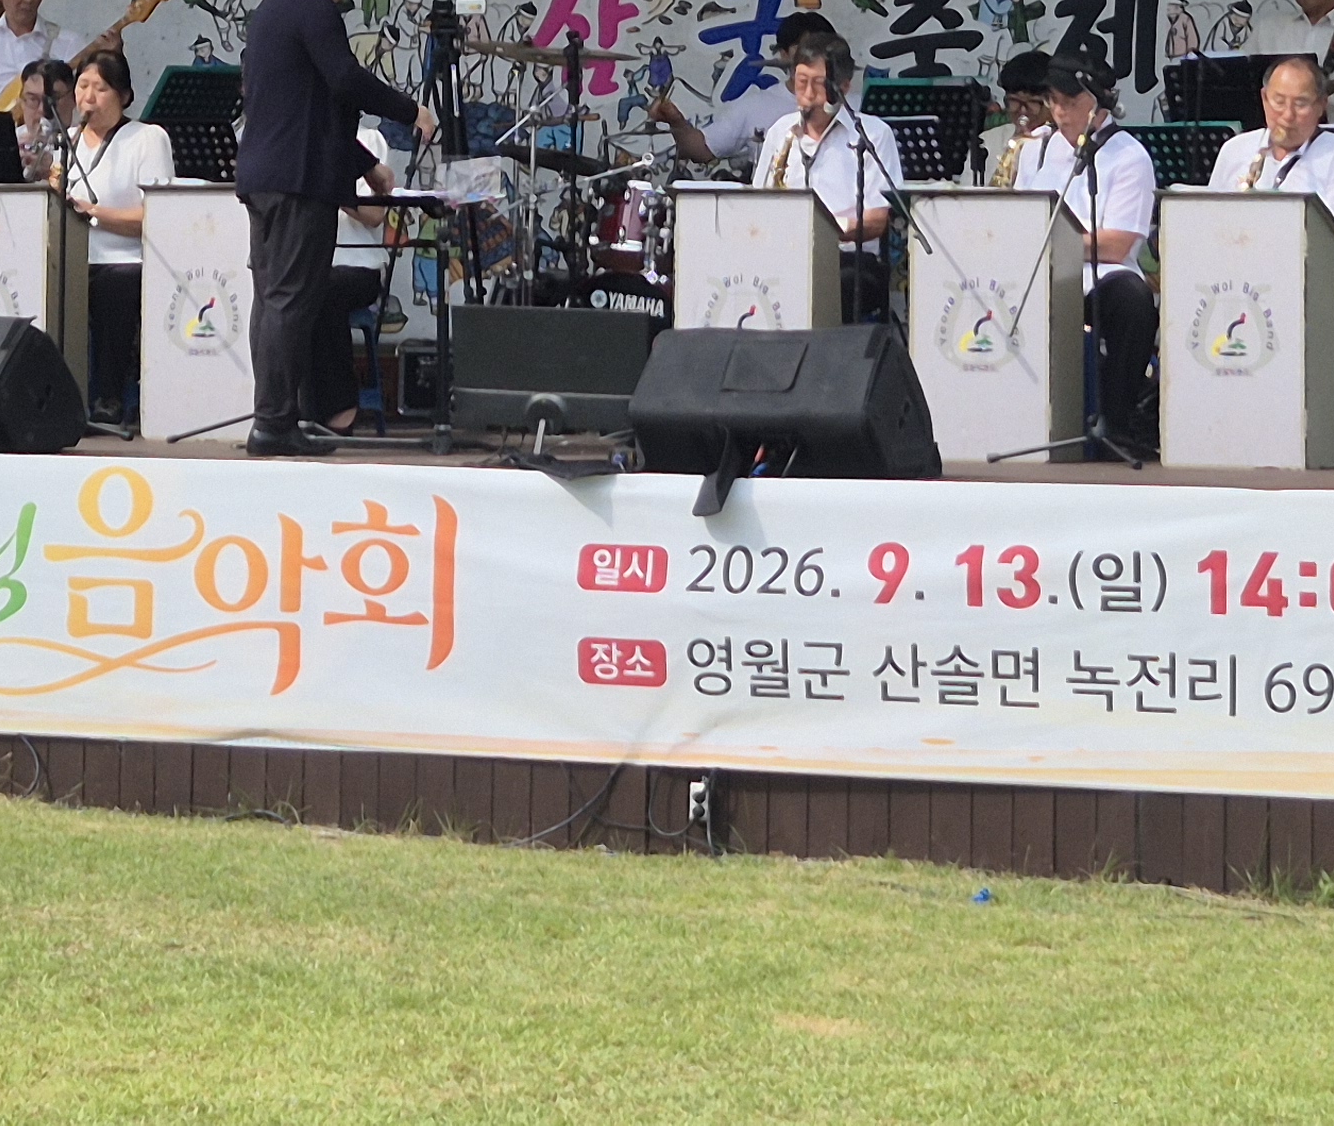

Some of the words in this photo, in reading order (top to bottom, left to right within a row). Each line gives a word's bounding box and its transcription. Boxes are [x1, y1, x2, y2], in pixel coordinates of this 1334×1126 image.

[608, 290, 664, 318] YAMAHA
[592, 547, 654, 588] 일시
[685, 544, 840, 598] 2026.
[867, 542, 925, 604] 9.
[590, 643, 655, 679] 장소
[686, 636, 851, 700] 영월군
[873, 643, 1040, 708] 산솔면
[1066, 649, 1237, 717] 녹전리
